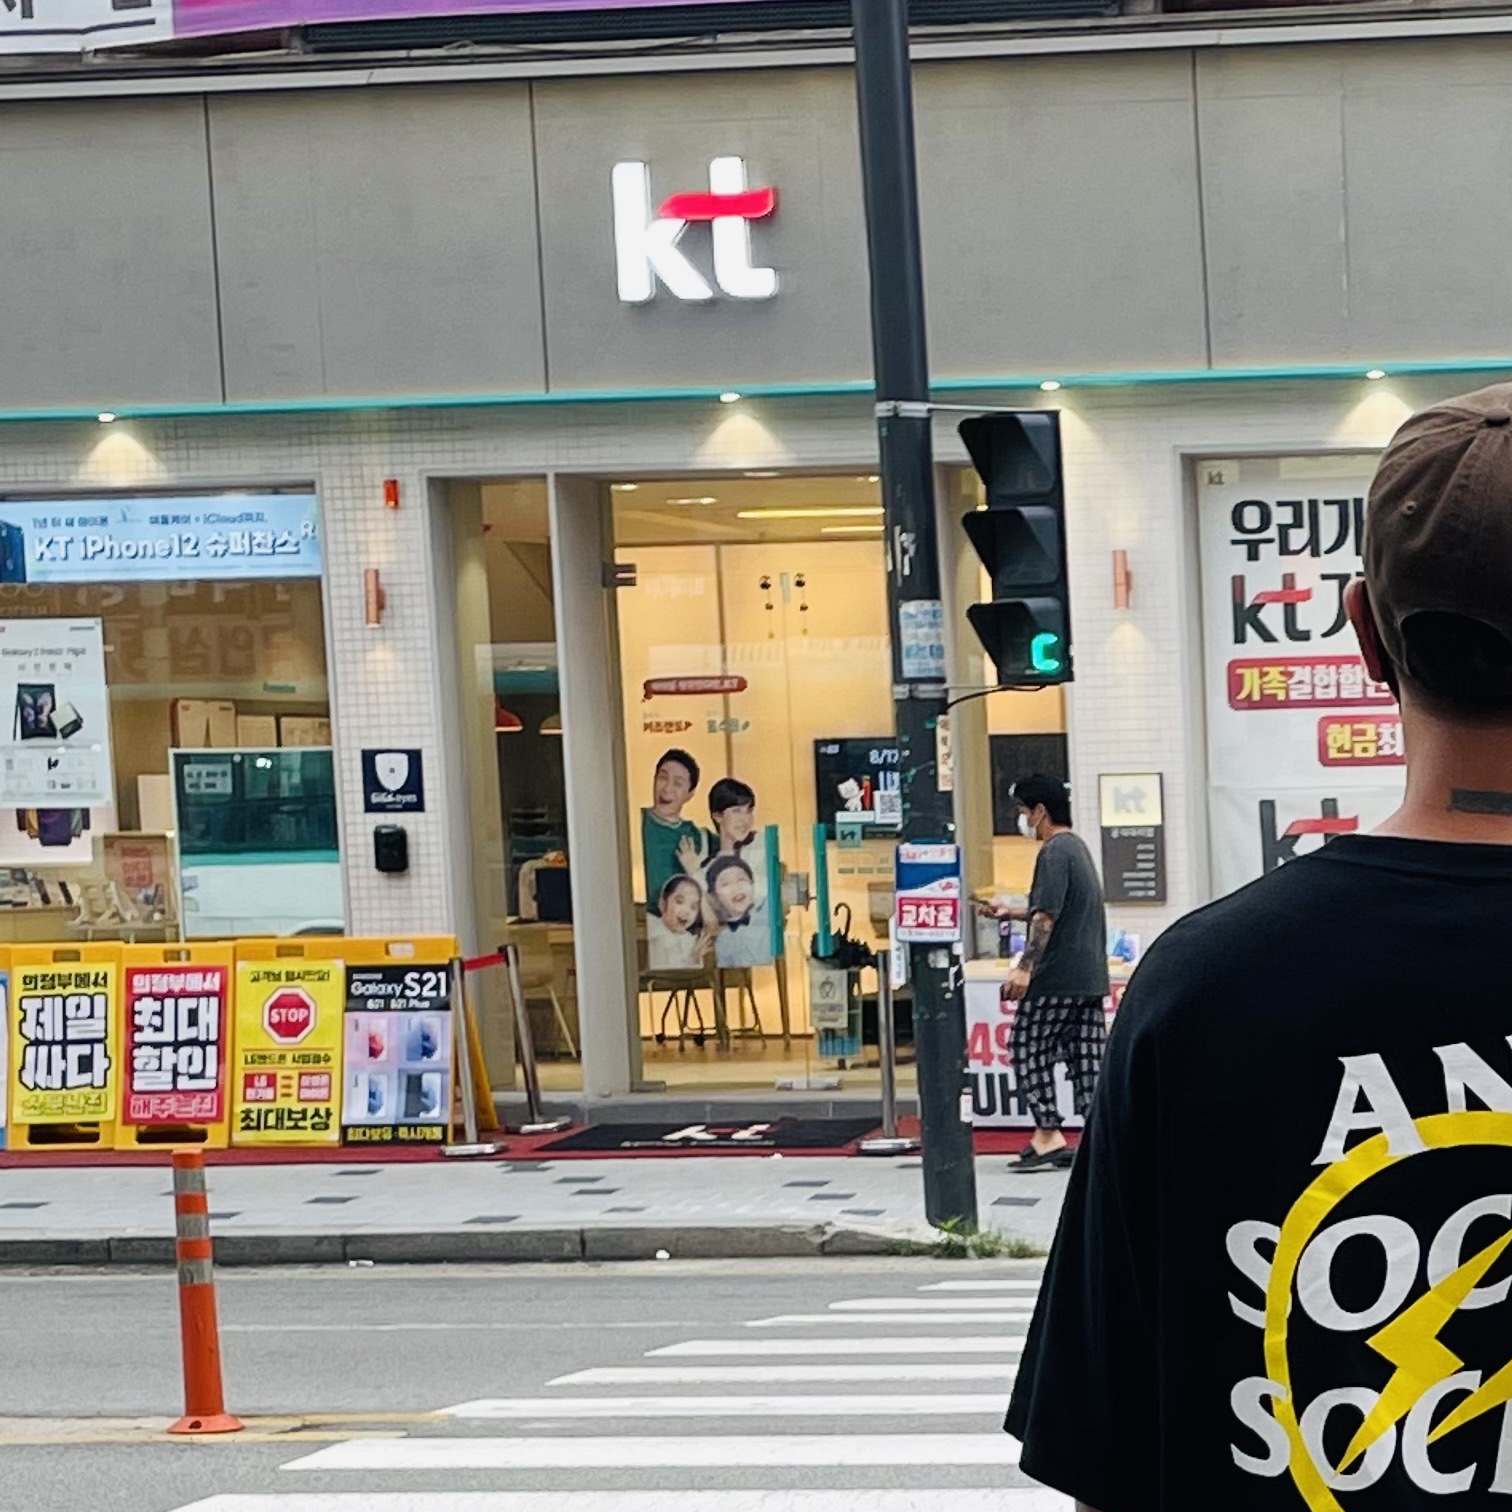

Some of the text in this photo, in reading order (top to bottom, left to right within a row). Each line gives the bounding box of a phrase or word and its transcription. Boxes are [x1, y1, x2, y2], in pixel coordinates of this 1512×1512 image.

[612, 156, 779, 301] kt
[35, 536, 75, 562] KT
[351, 971, 447, 997] Galaxy S21
[21, 994, 106, 1041] 제일
[133, 996, 219, 1042] 최대
[270, 1008, 309, 1024] STOP
[21, 1042, 111, 1091] 싸다
[132, 1045, 218, 1091] 할인
[240, 1107, 333, 1131] 최대보상
